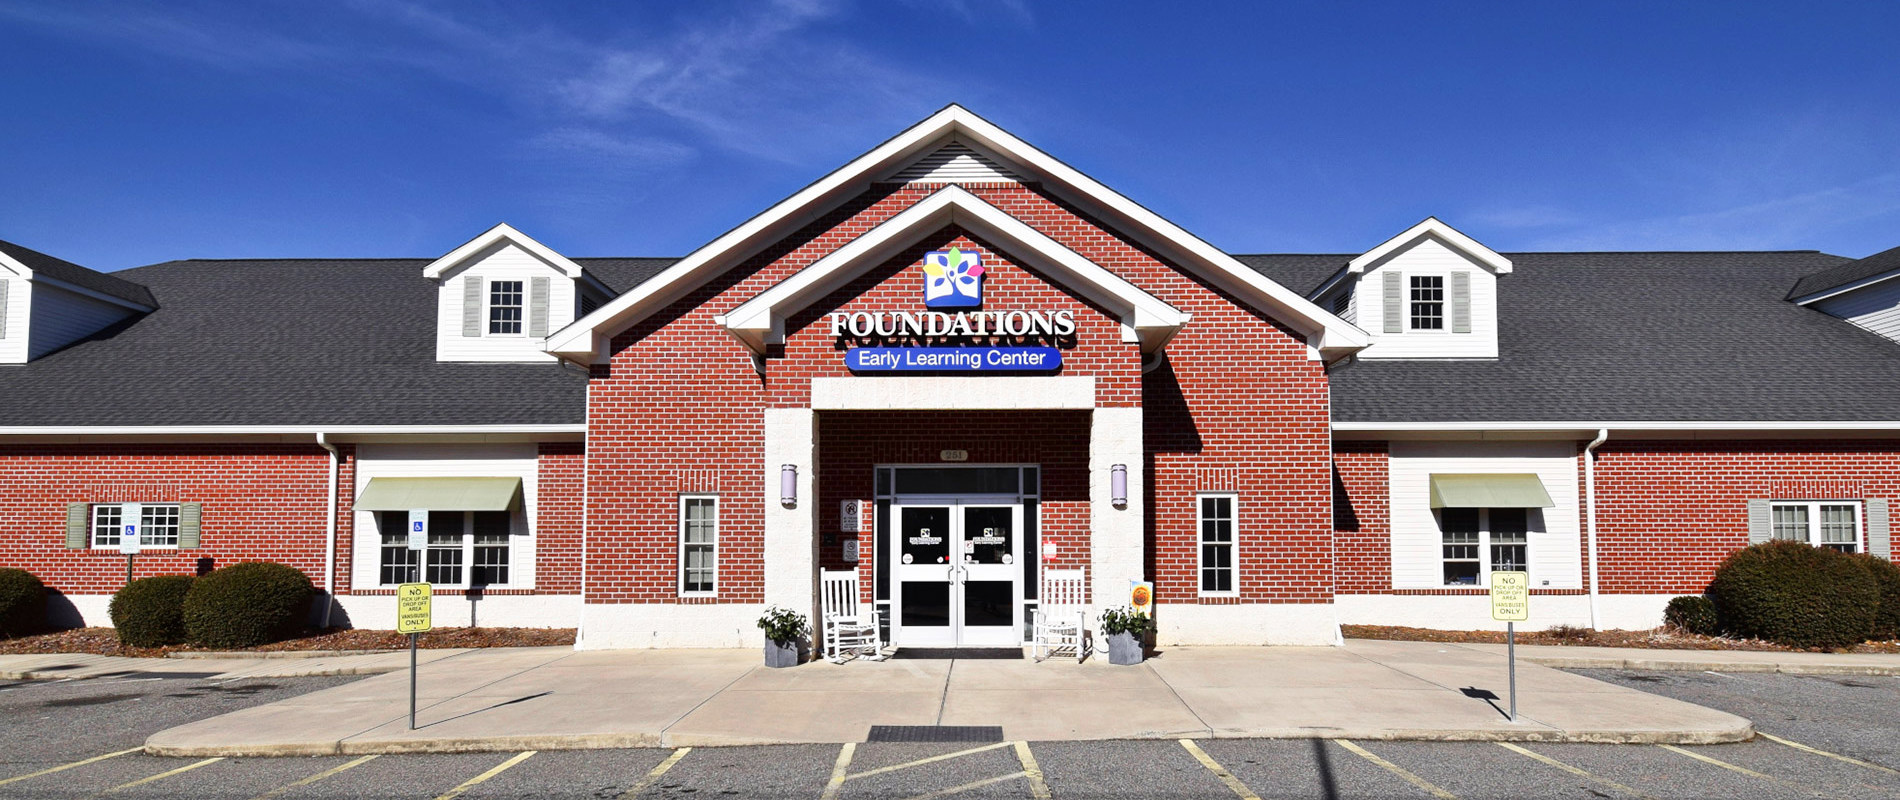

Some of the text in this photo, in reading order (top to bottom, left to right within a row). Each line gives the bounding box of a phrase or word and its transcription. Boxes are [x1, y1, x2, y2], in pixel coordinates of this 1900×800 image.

[829, 310, 1076, 337] FOUNDATIONS
[858, 350, 1047, 369] Early Learning Center
[1502, 577, 1516, 585] NO
[409, 588, 422, 596] NO
